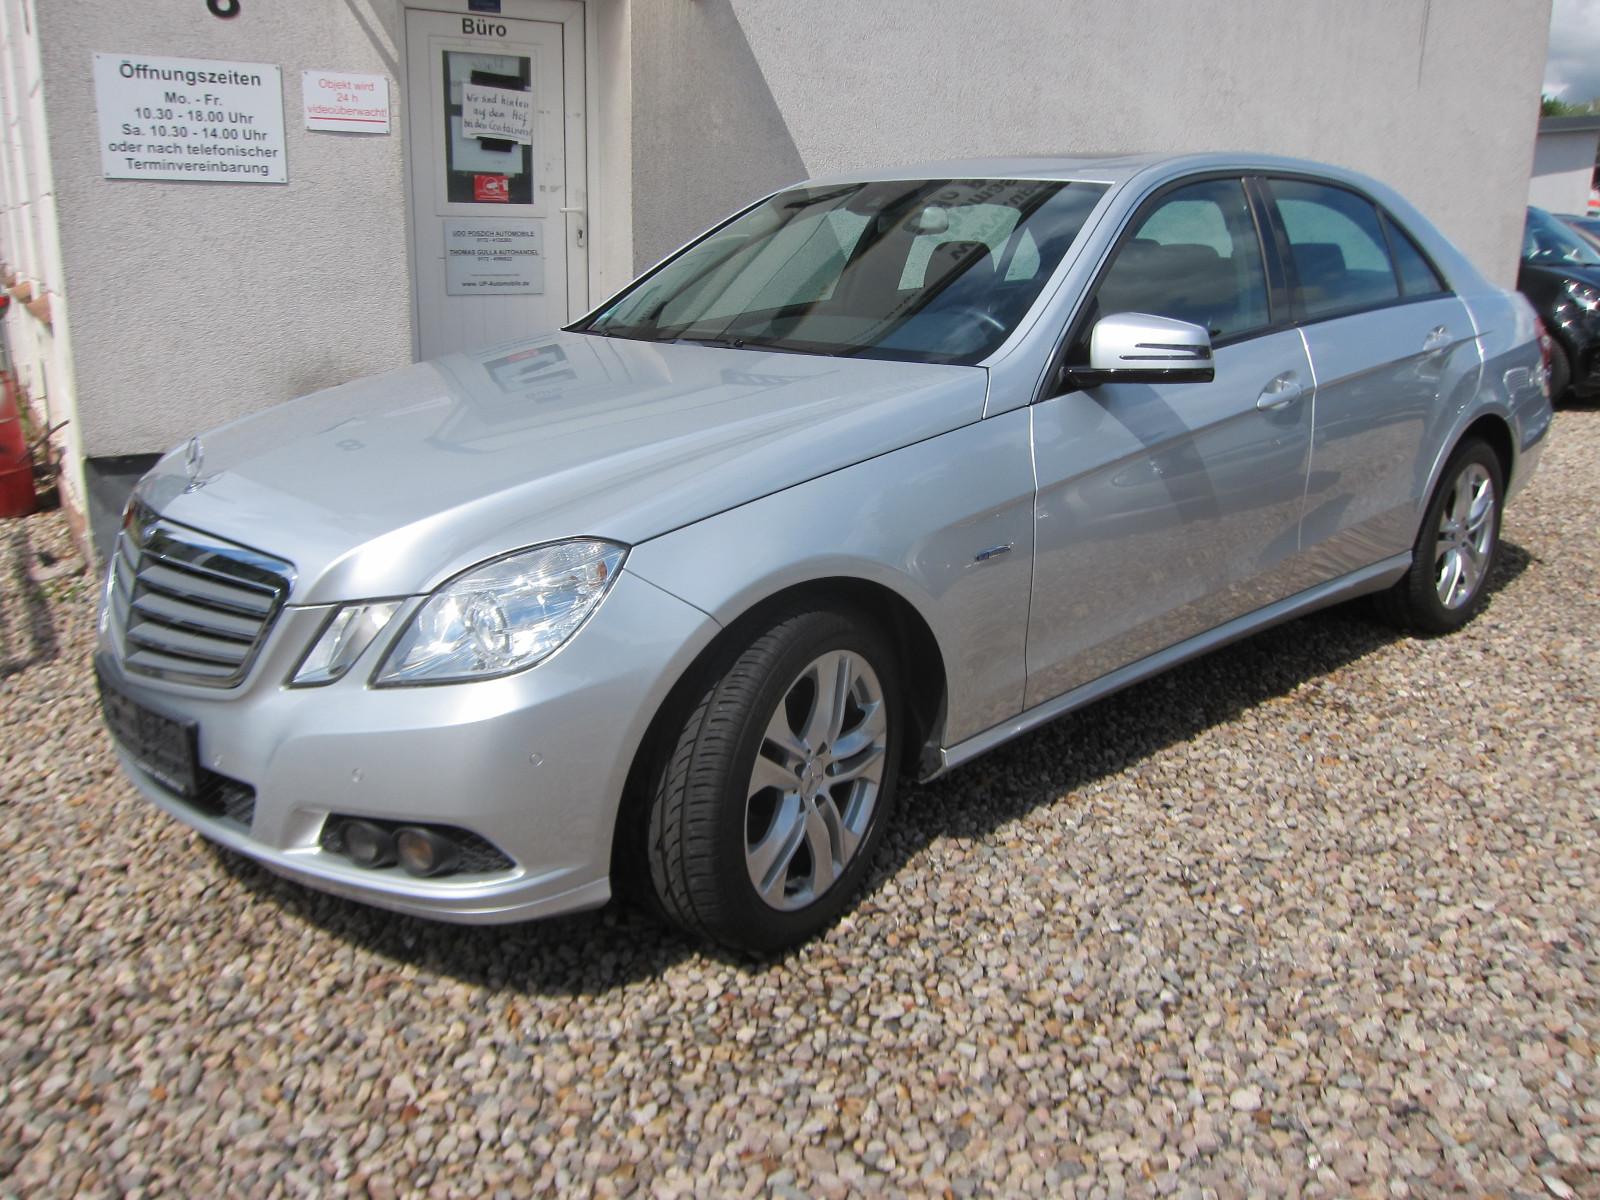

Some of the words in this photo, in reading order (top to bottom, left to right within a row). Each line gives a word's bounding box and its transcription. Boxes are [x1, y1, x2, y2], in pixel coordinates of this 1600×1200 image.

[462, 18, 507, 37] Büro
[119, 59, 262, 87] Öffnungszeiten
[318, 78, 352, 91] Objekt
[353, 81, 375, 92] wird
[164, 91, 191, 105] Mo.
[204, 94, 222, 106] Fr.
[336, 92, 349, 102] 24
[351, 94, 359, 102] h
[466, 93, 479, 103] Wir
[481, 94, 497, 104] sind
[501, 95, 529, 108] hinten
[135, 107, 173, 121] 10.30
[188, 110, 224, 123] 18.00
[228, 112, 254, 125] Uhr
[473, 108, 486, 120] auf
[121, 124, 145, 137] Sa.
[150, 126, 187, 139] 10.30
[202, 128, 238, 141] 14.00
[243, 129, 267, 142] Uhr
[108, 141, 143, 153] oder
[147, 143, 182, 156] nach
[187, 143, 278, 158] telefonischer
[125, 158, 270, 177] Terminvereinbarung
